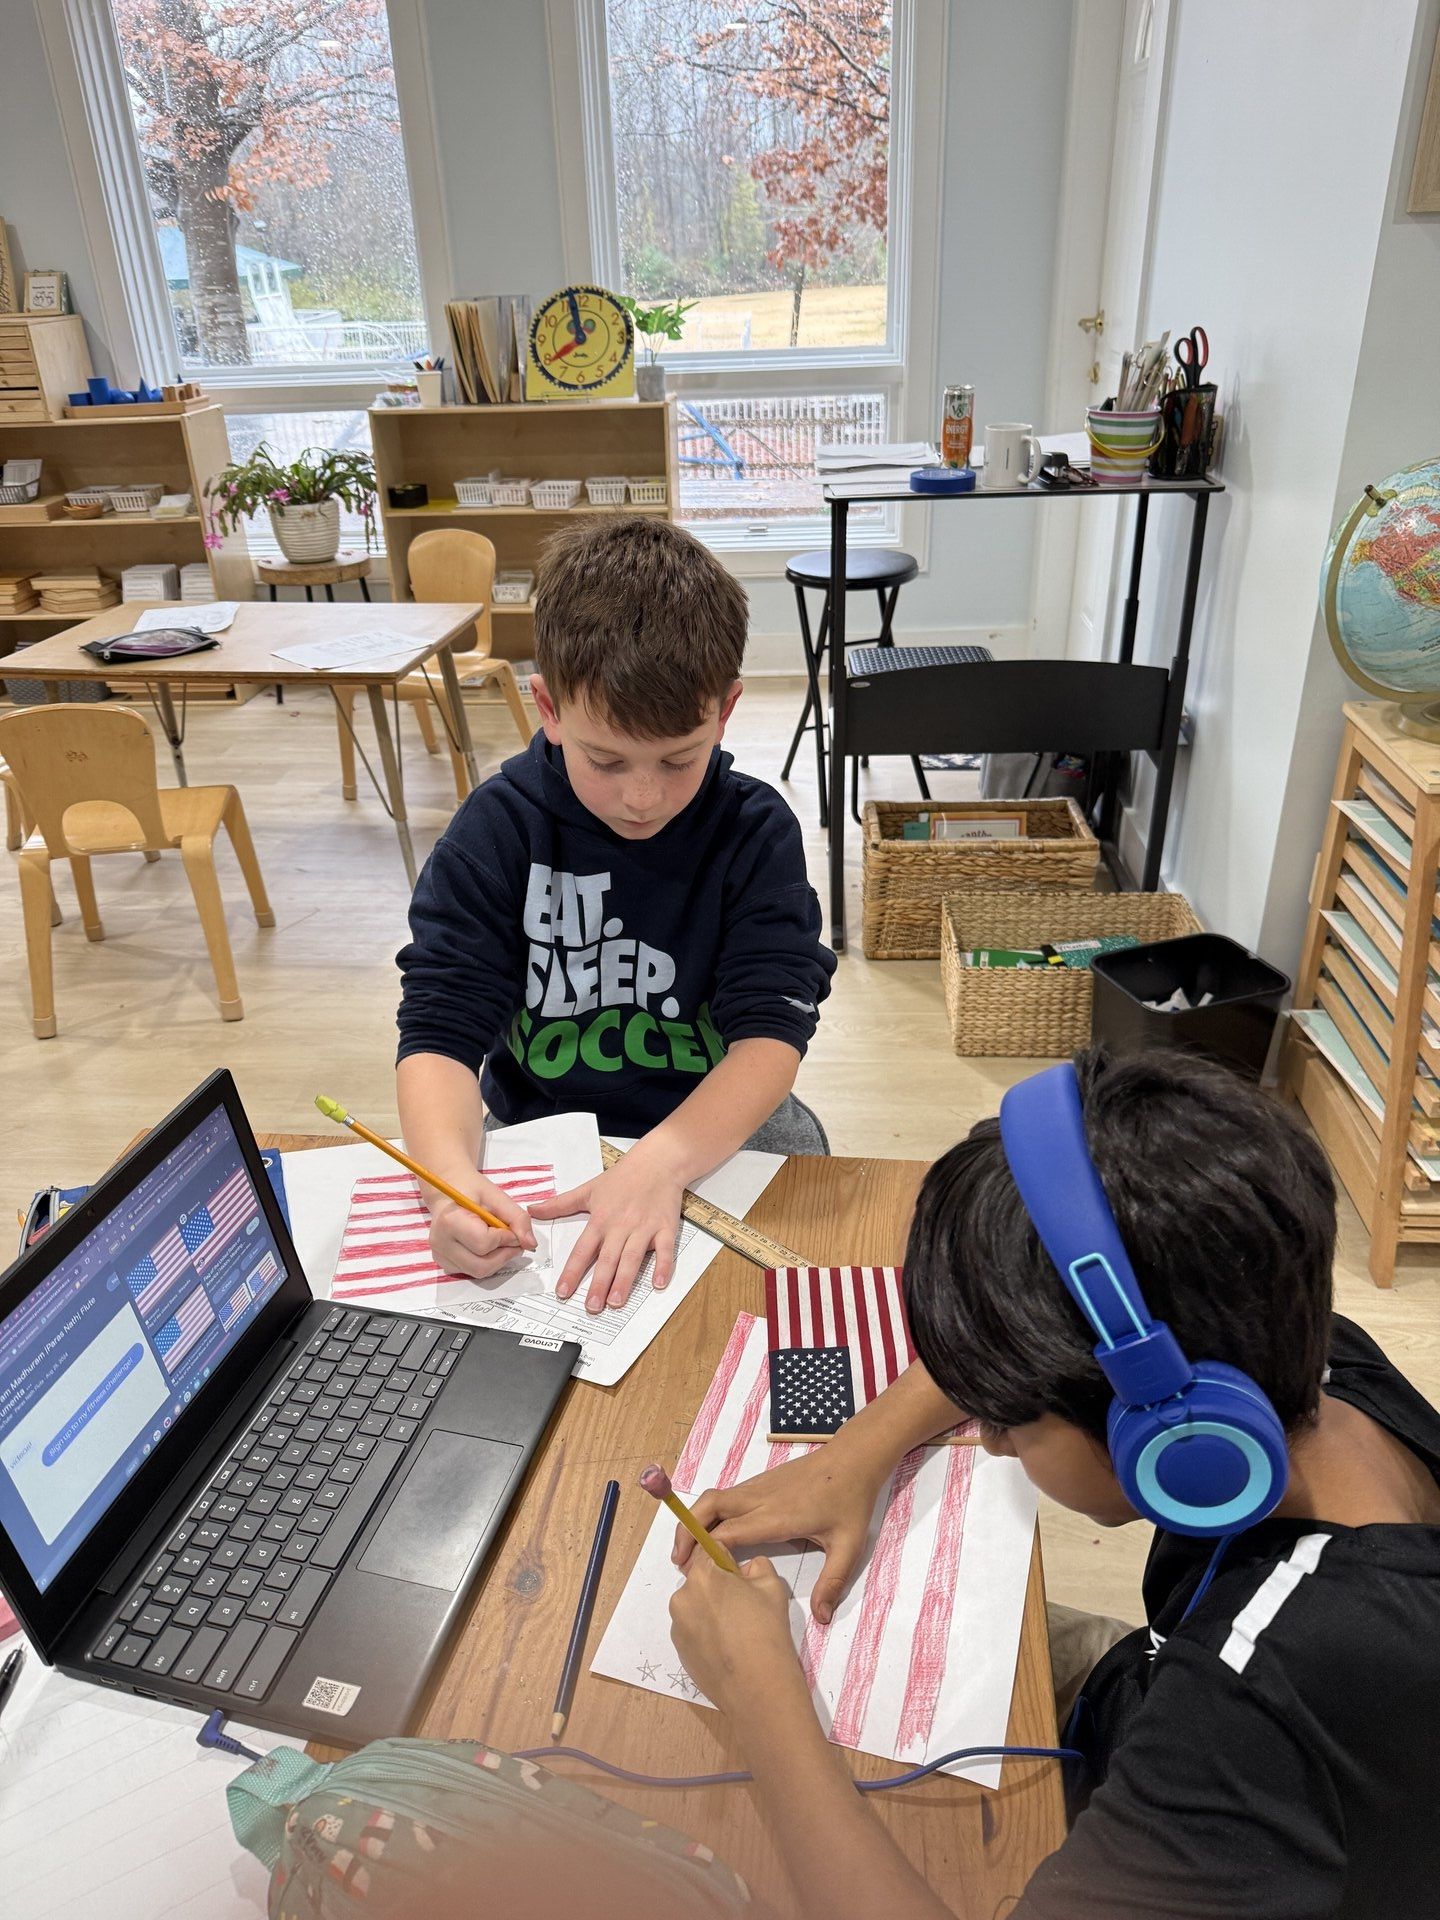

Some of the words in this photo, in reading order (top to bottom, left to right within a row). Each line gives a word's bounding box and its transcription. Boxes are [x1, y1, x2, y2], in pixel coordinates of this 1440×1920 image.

[578, 295, 589, 307] 12
[599, 299, 602, 310] 1
[545, 315, 558, 327] 10
[612, 313, 620, 325] 2
[538, 334, 546, 346] 9
[617, 332, 625, 344] 3
[609, 352, 617, 362] 4
[560, 366, 568, 378] 7
[577, 371, 585, 383] 6
[596, 365, 603, 377] 5
[952, 404, 967, 417] V8
[523, 863, 623, 947] EAT.
[526, 939, 680, 1018] SLEEP.
[10, 1349, 45, 1391] Madhuram
[79, 1294, 96, 1316] Flute
[523, 1337, 558, 1349] Lenovo
[0, 1386, 25, 1419] umenta
[49, 1436, 64, 1459] Sign
[63, 1427, 73, 1443] up
[71, 1419, 79, 1431] to
[78, 1410, 88, 1425] my
[86, 1386, 106, 1413] fitness
[258, 1549, 267, 1557] d
[216, 1669, 228, 1683] shift
[356, 1442, 365, 1451] m
[154, 1655, 165, 1667] tab
[206, 1577, 215, 1585] w
[248, 1679, 258, 1691] ctrl
[290, 1611, 298, 1620] alt
